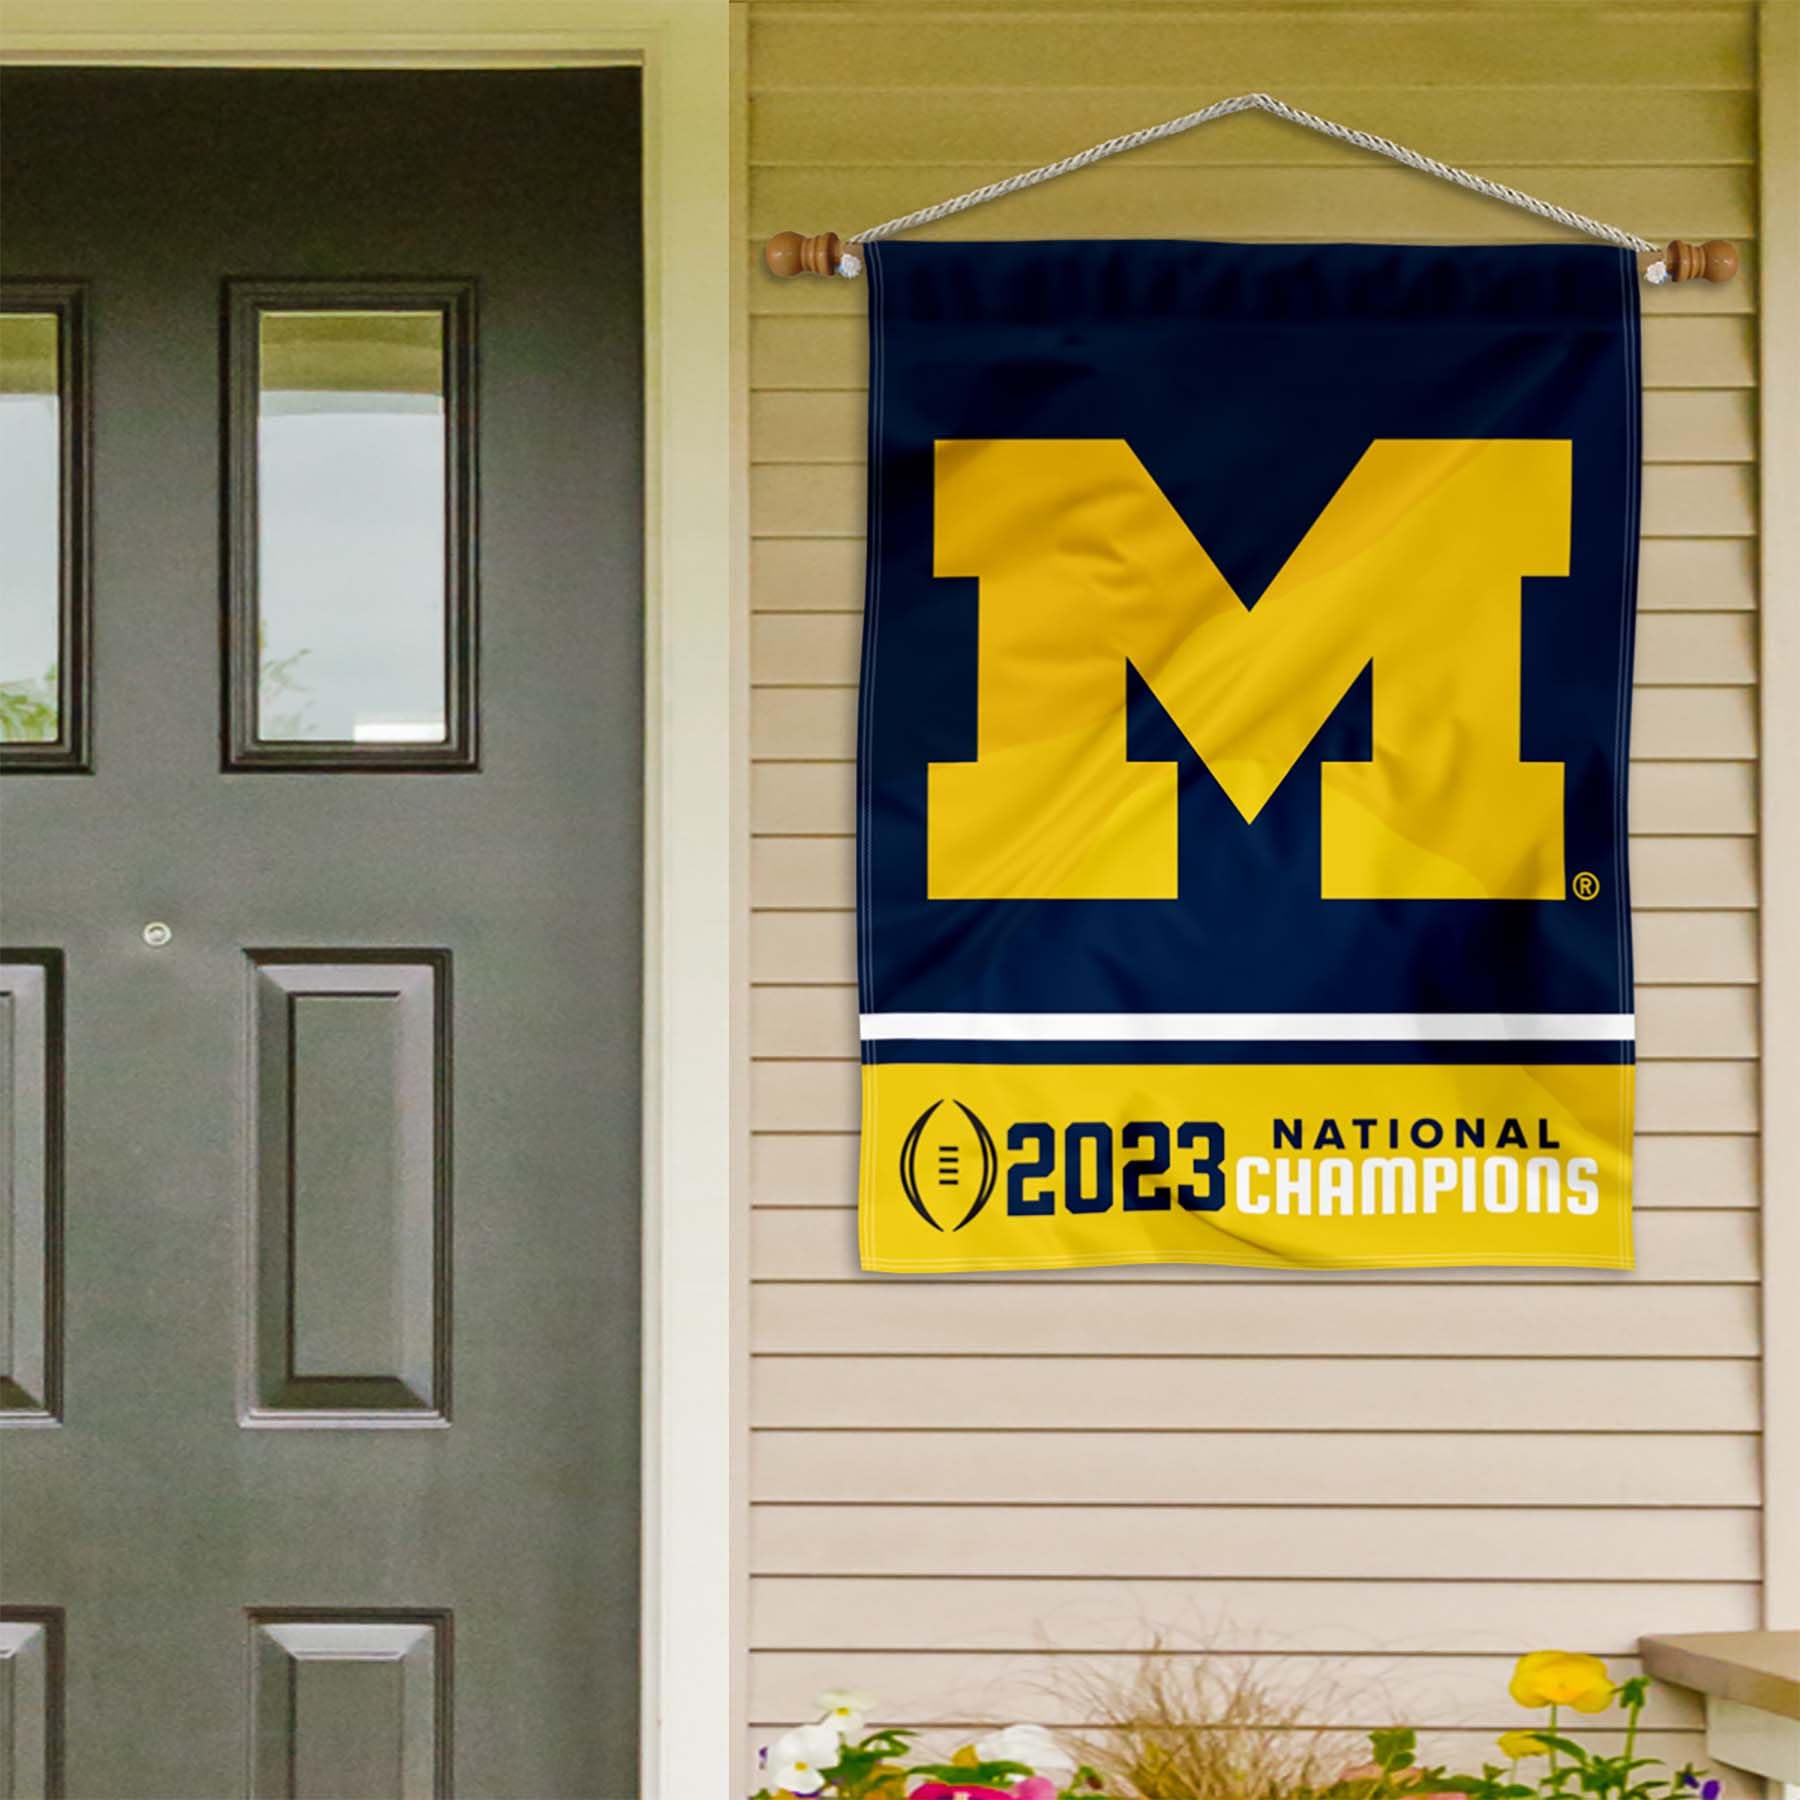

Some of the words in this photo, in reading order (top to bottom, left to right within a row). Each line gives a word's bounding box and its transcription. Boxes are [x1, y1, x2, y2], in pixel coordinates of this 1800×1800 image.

[926, 438, 1572, 901] M
[1006, 1121, 1226, 1216] 2023
[1273, 1117, 1560, 1150] NATIONAL
[1235, 1155, 1599, 1216] CHAMPIONS
